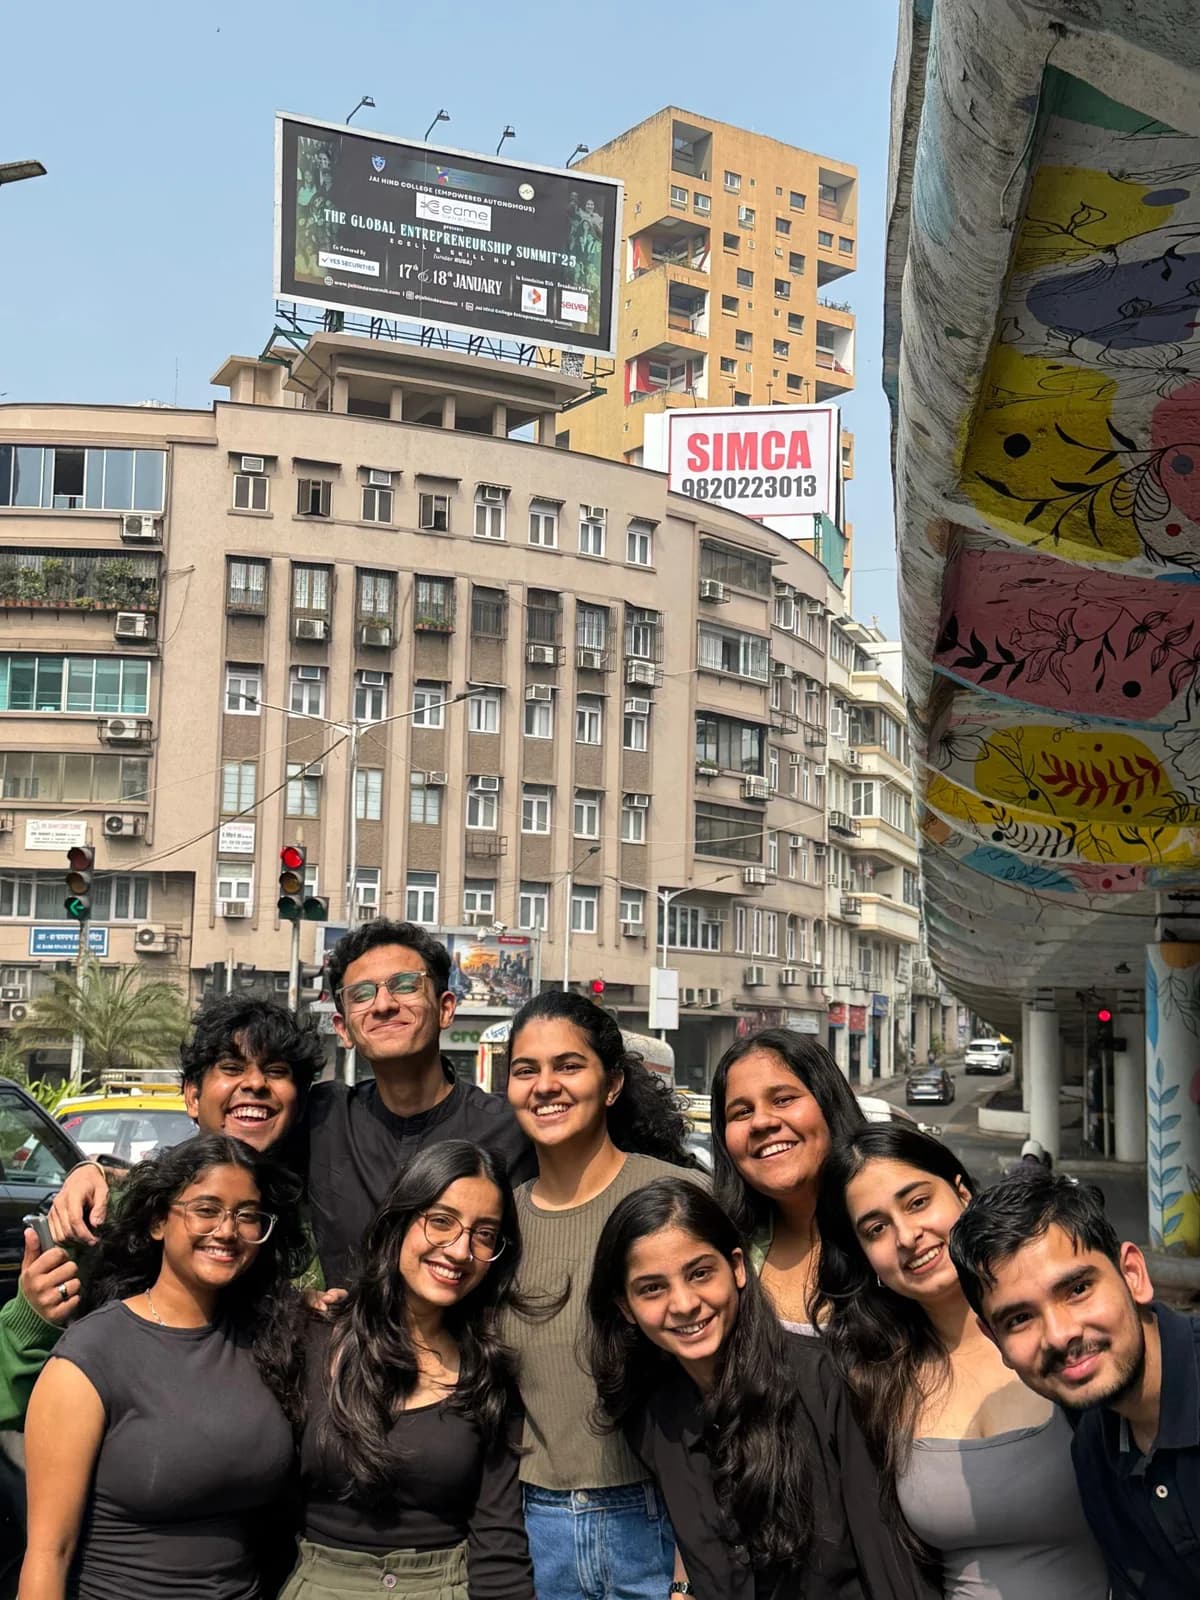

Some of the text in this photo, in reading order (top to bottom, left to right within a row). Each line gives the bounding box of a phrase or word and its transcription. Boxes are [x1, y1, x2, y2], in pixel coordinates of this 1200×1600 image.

[369, 175, 380, 183] JAI
[381, 177, 399, 187] HIND
[401, 181, 433, 194] COLLEGE
[483, 197, 536, 214] AUTONOMOUS)
[323, 209, 346, 225] THE
[350, 214, 396, 234] GLOBAL
[400, 223, 512, 256] ENTREPRENEURSHIP
[329, 257, 340, 265] YES
[453, 273, 503, 296] JANUARY
[687, 430, 812, 473] SIMCA
[681, 475, 817, 500] 9820223013
